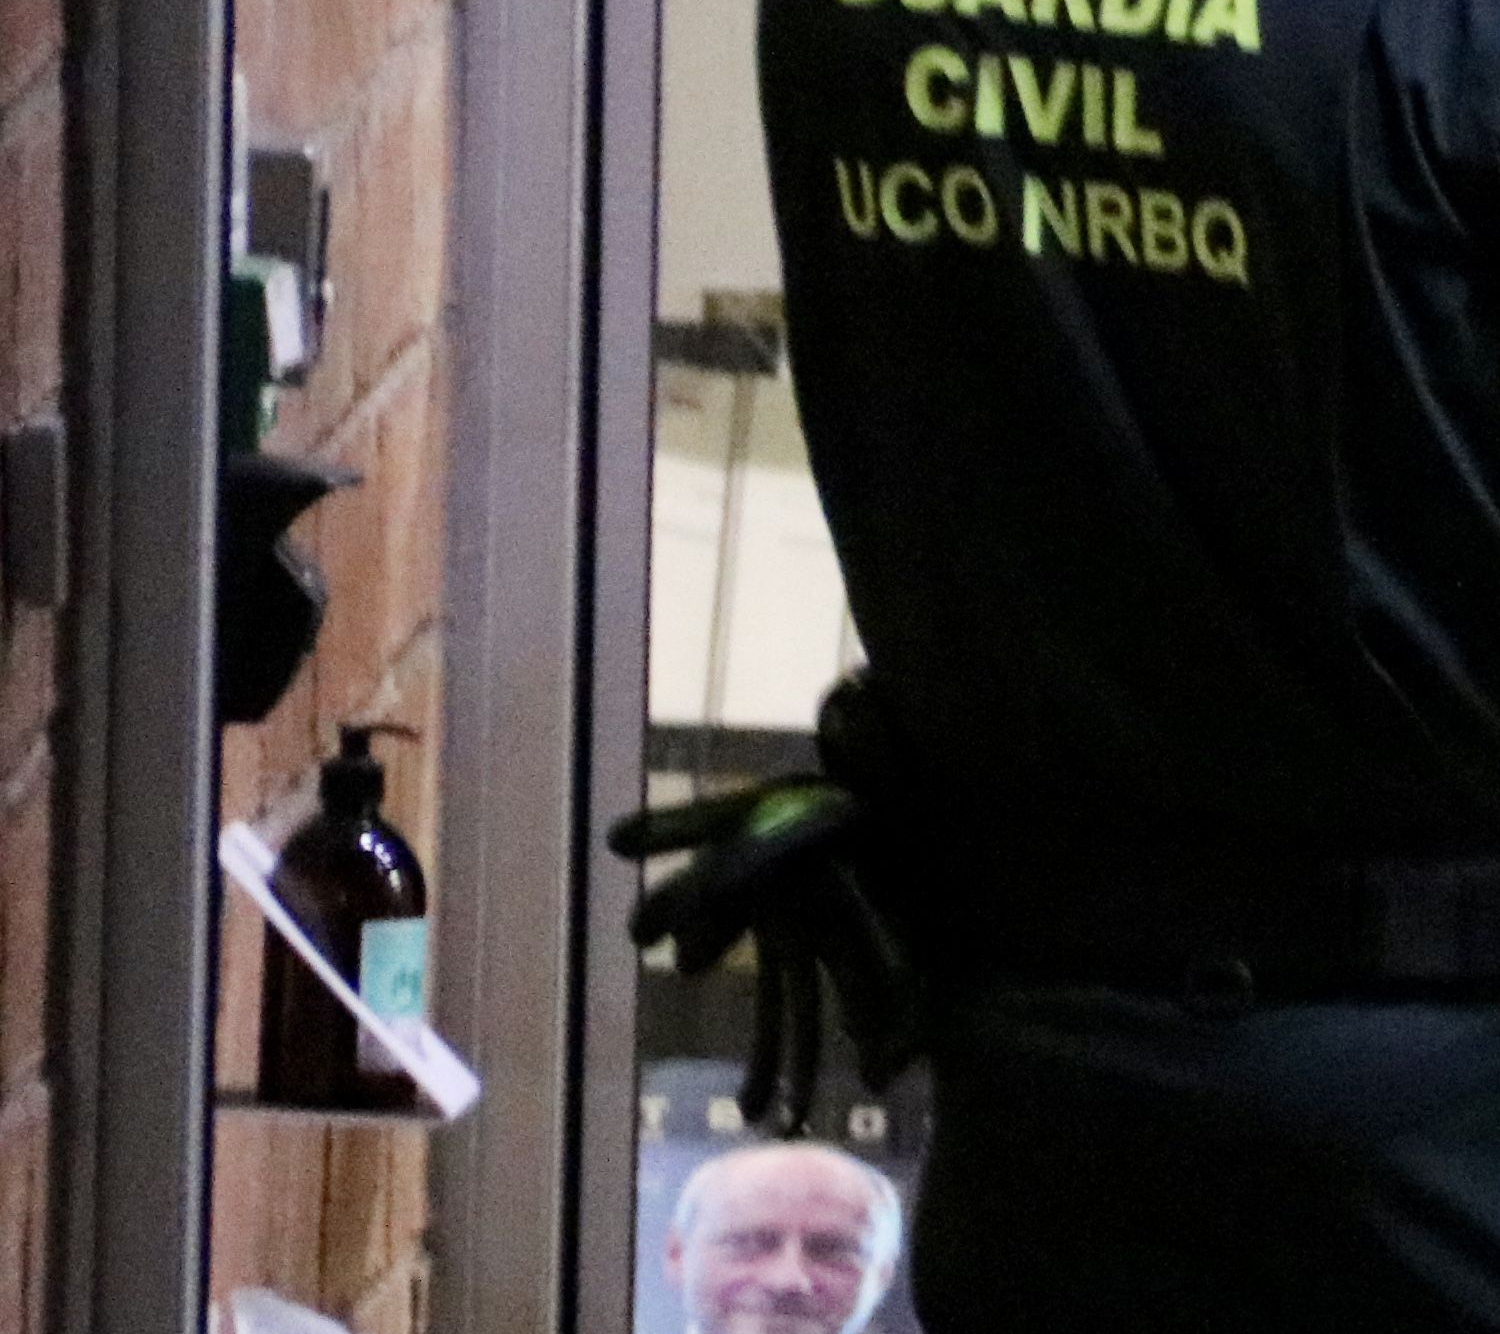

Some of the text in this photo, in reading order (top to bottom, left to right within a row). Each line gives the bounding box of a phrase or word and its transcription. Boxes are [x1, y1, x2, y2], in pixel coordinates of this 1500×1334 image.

[904, 44, 1164, 158] CIVIL
[834, 157, 1249, 291] UCO NRBQ
